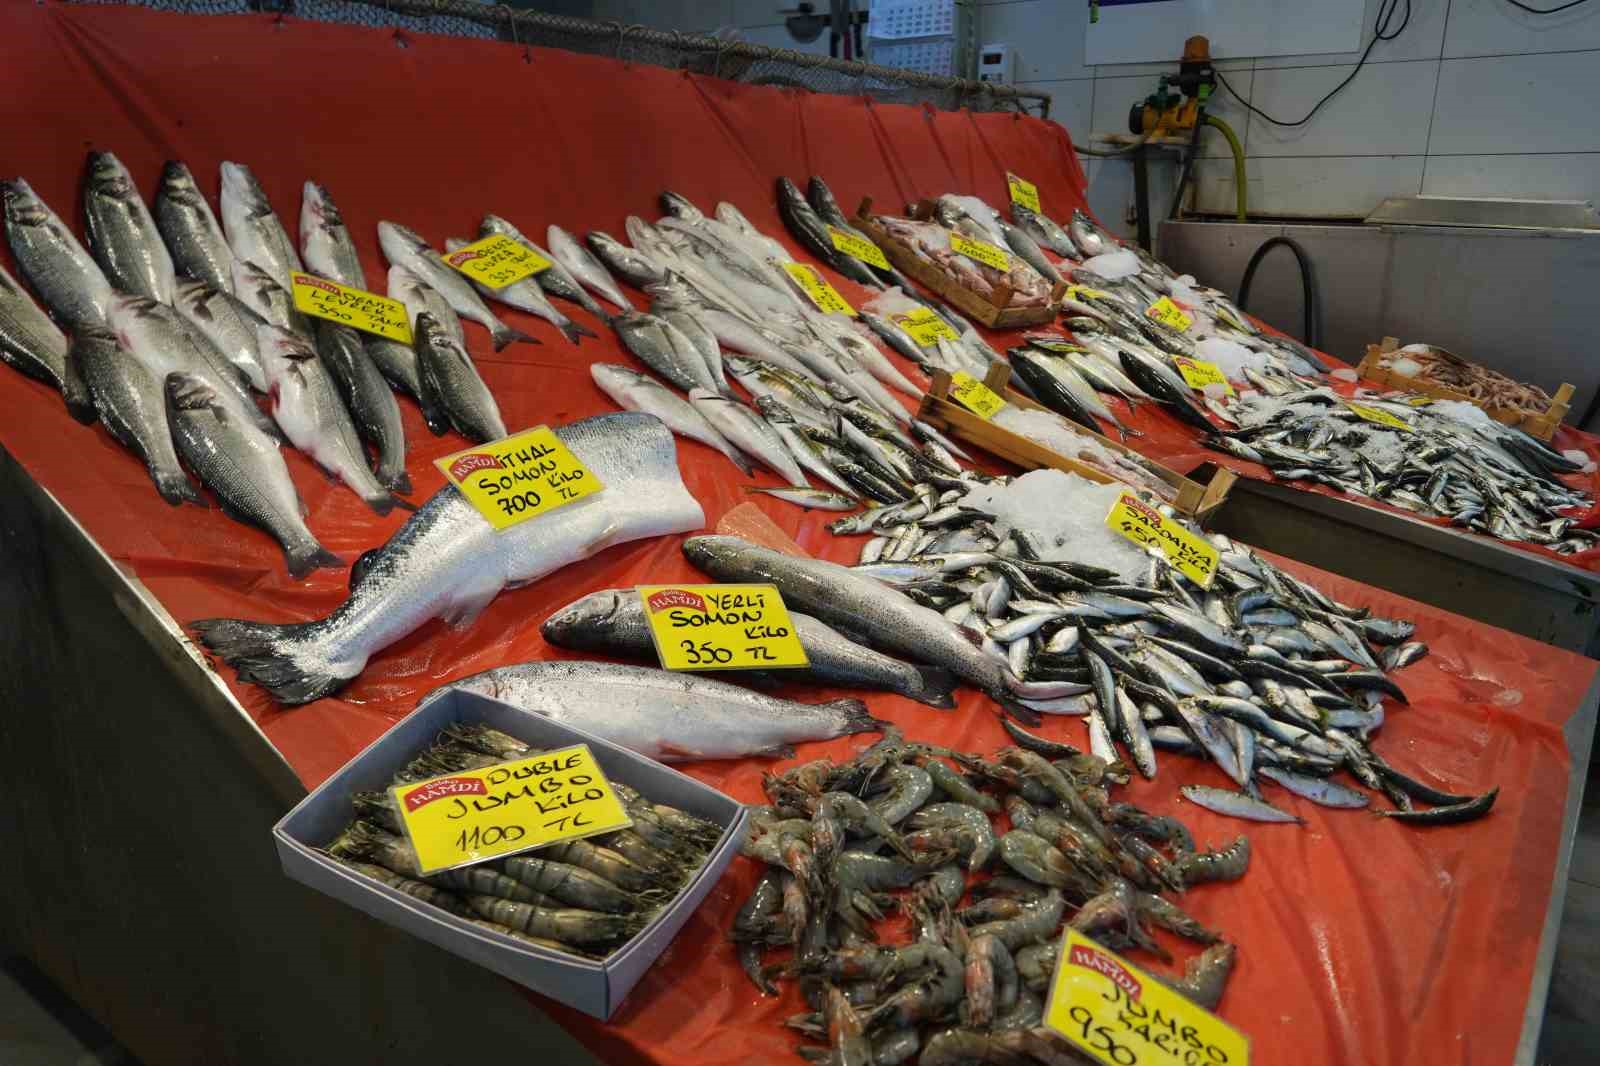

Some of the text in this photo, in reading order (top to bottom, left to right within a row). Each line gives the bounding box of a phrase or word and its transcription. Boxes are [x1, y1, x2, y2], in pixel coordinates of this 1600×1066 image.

[312, 290, 385, 314] LEVREK
[313, 302, 352, 320] 350
[479, 460, 557, 496] SOMON
[497, 487, 579, 516] 700 TL
[706, 592, 766, 610] YERLİ
[669, 611, 762, 627] SOMON
[744, 626, 789, 639] KİLO
[680, 640, 777, 664] 350 TL
[486, 753, 583, 785] DUBLE
[447, 775, 593, 819] JUMBO
[534, 788, 604, 815] KİLO
[455, 825, 525, 852] 1100
[1070, 1006, 1137, 1066] 950
[1102, 982, 1228, 1063] JUMBO
